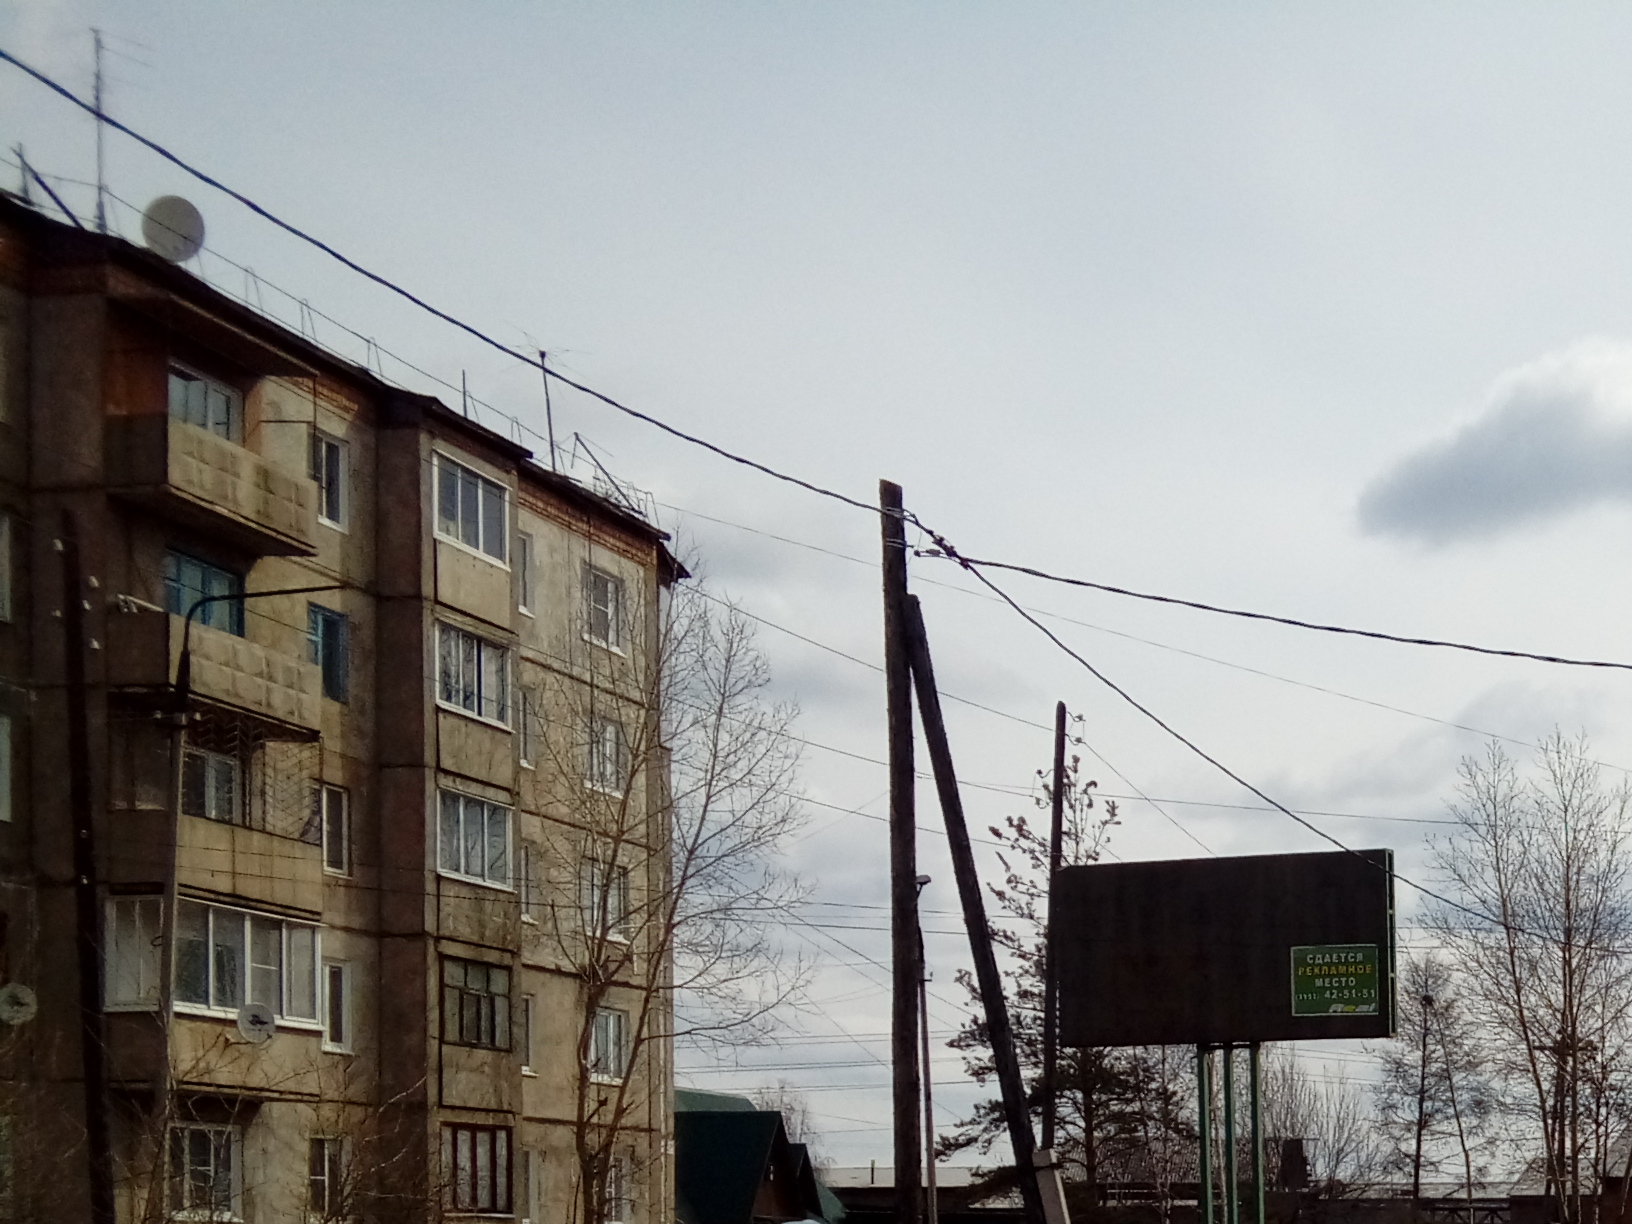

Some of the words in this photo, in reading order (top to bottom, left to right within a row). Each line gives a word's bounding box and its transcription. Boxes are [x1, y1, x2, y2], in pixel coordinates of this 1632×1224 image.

[1307, 953, 1363, 964] СДАЕТСЯ
[1298, 964, 1372, 976] РЕКЛАМНОЕ
[1315, 976, 1356, 987] МЕСТО
